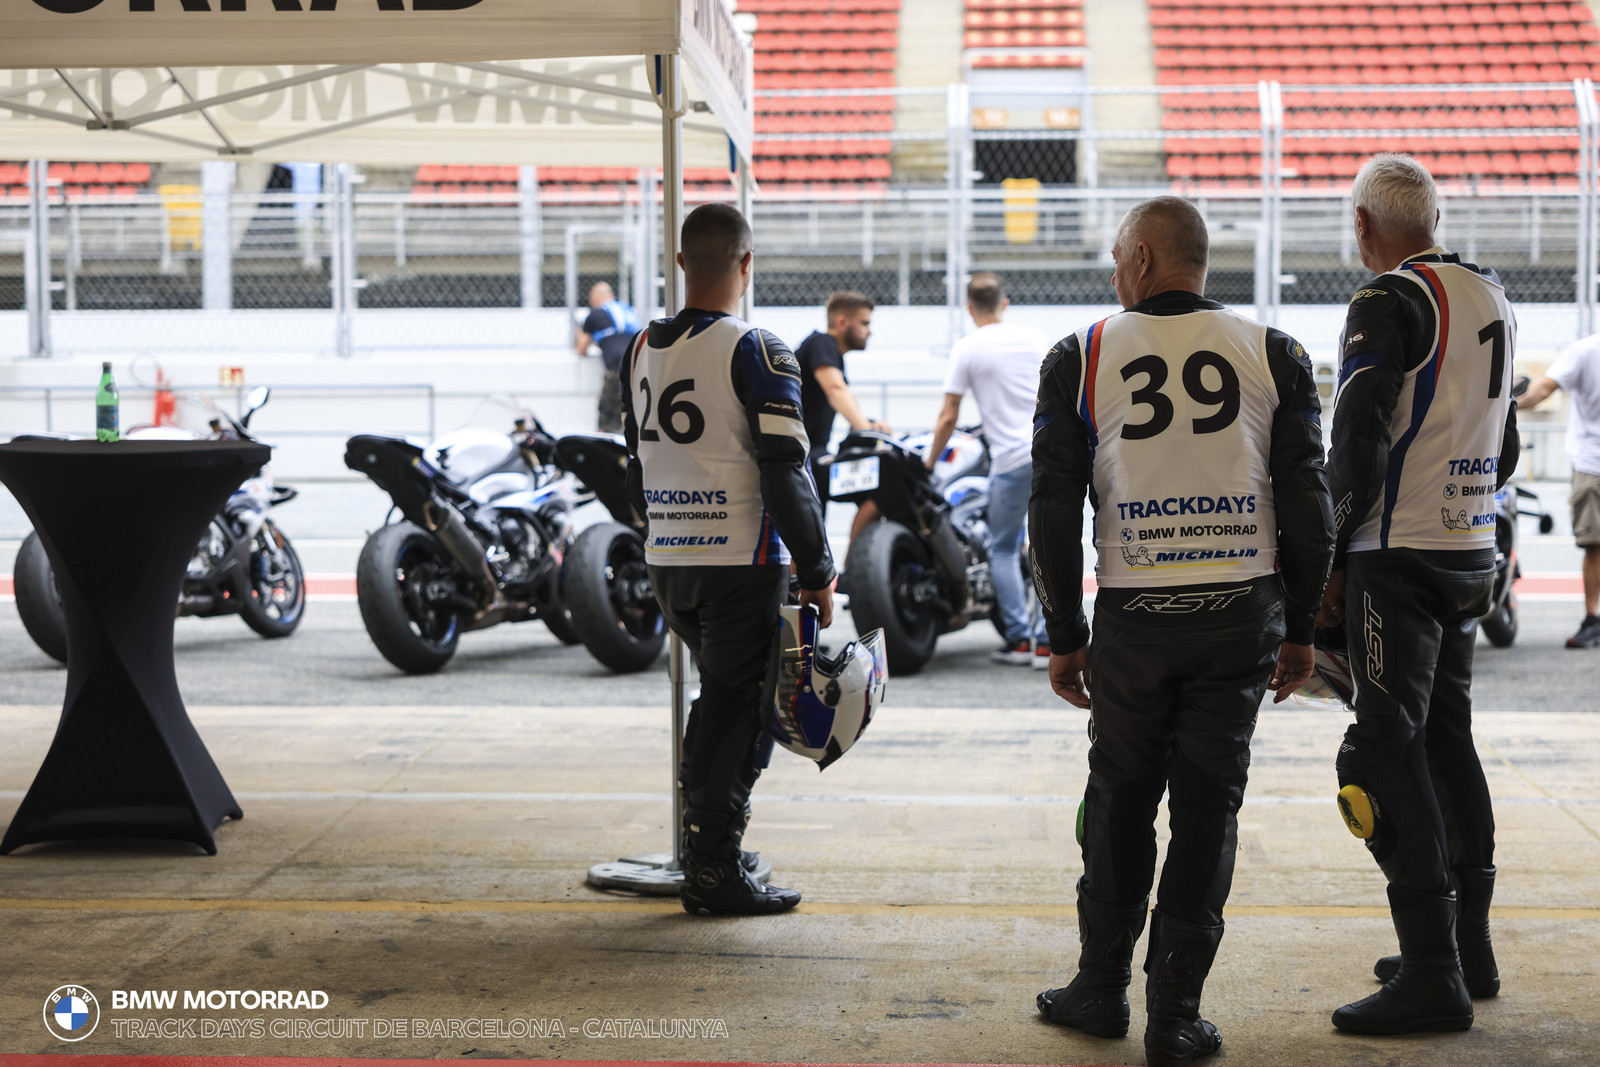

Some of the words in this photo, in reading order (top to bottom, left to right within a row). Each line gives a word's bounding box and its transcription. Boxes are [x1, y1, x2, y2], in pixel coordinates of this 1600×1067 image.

[1477, 319, 1514, 399] 1
[1119, 350, 1241, 440] 39
[639, 376, 705, 444] 26
[1462, 485, 1487, 497] BMW
[666, 511, 728, 520] MOTORRAD
[1117, 495, 1256, 520] TRACKDAYS
[1471, 513, 1497, 527] MICH
[654, 536, 729, 546] MICHELIN
[1138, 527, 1176, 541] BMW
[1180, 524, 1258, 537] MOTORRAD
[1155, 548, 1259, 562] MICHELIN
[1122, 585, 1254, 614] RST
[1363, 590, 1389, 694] RST
